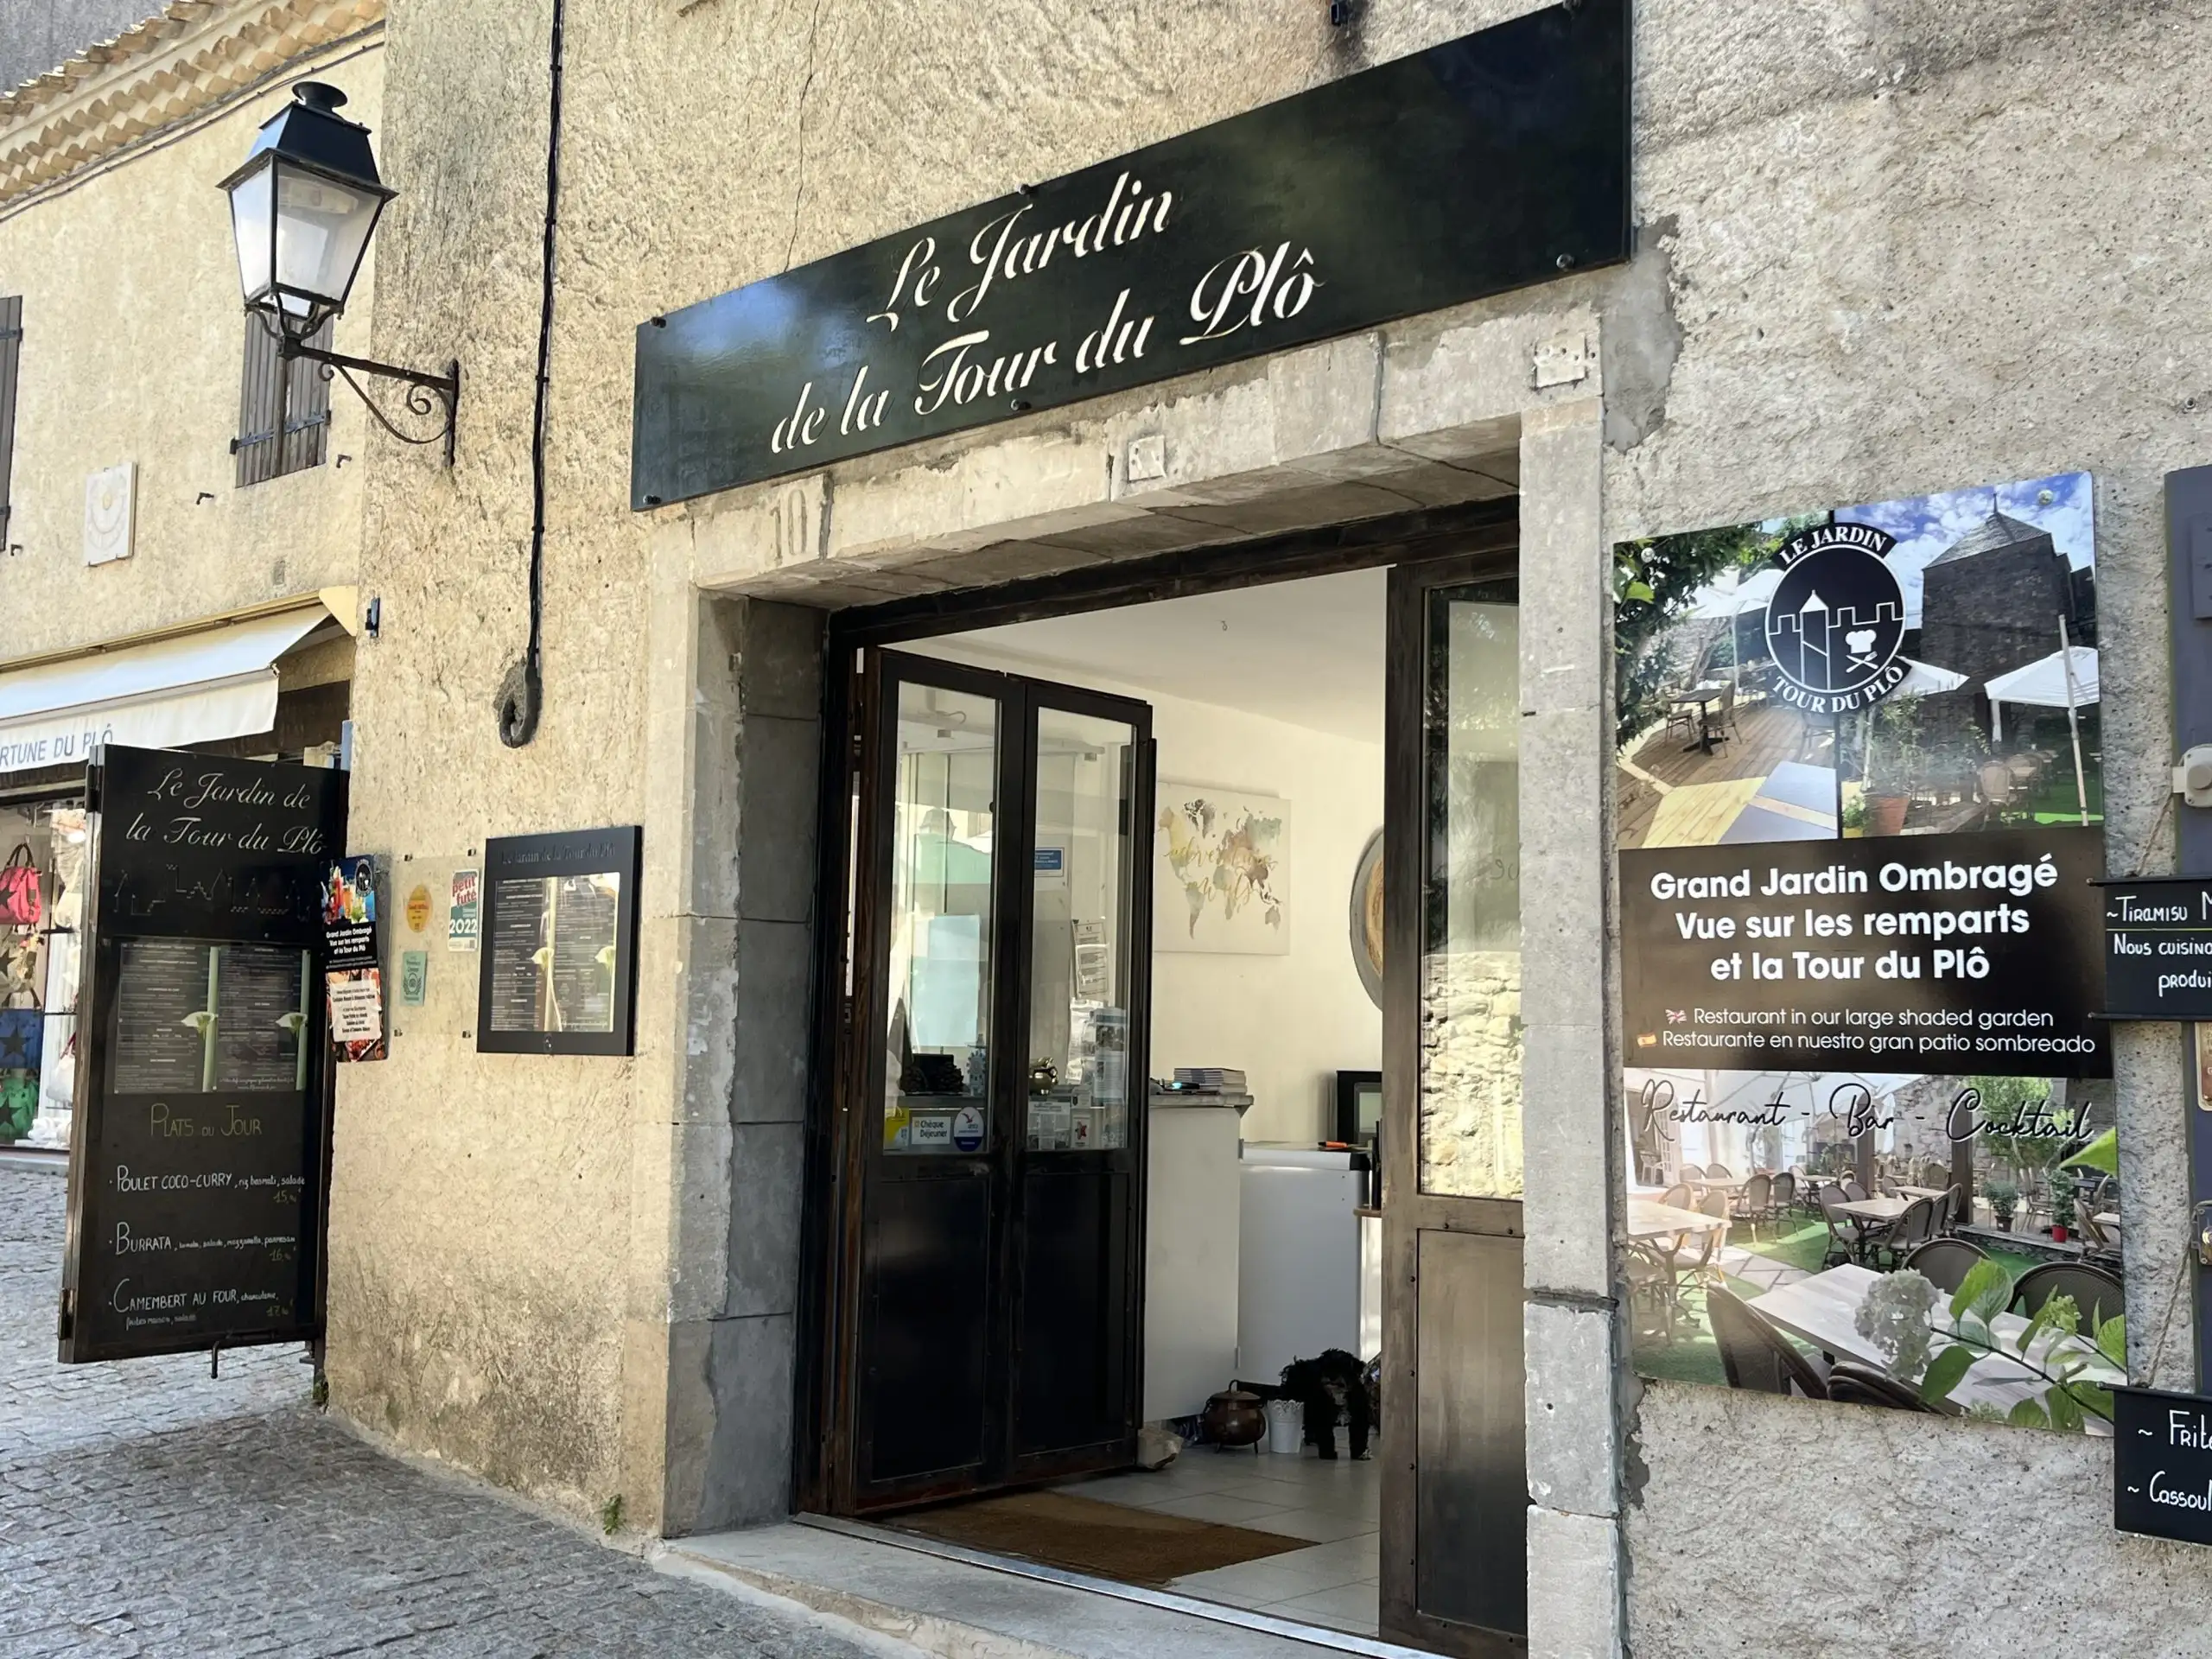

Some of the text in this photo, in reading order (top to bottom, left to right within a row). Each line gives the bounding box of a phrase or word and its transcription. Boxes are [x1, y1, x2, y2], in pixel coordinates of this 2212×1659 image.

[867, 172, 1173, 332] Le Jardin
[772, 241, 1322, 454] de la Tour du Plô
[1779, 526, 1887, 564] LE JARDIN
[1772, 665, 1904, 714] TOUR DU PLÔ
[54, 734, 74, 758] DU
[148, 768, 310, 809] Le Jardin de
[126, 812, 151, 841] la
[164, 817, 232, 847] Tour
[238, 823, 269, 849] du
[452, 875, 475, 897] petit
[1651, 853, 2057, 900] Grand Jardin Ombragé
[456, 890, 476, 906] futé
[449, 918, 478, 934] 2022
[1675, 904, 2030, 942] Vue sur les remparts
[2114, 933, 2152, 956] Nous
[1711, 946, 1990, 981] et la Tour du Plô
[1694, 1007, 2054, 1033] Restaurant in our large shaded garden
[1662, 1031, 2095, 1055] Restaurante en nuestro gran patio sombreado
[1641, 1078, 2095, 1143] Restaurant Bar Cocktail
[118, 1166, 158, 1192] POULET
[114, 1279, 187, 1313] CAMEMBERT
[193, 1294, 206, 1306] AU
